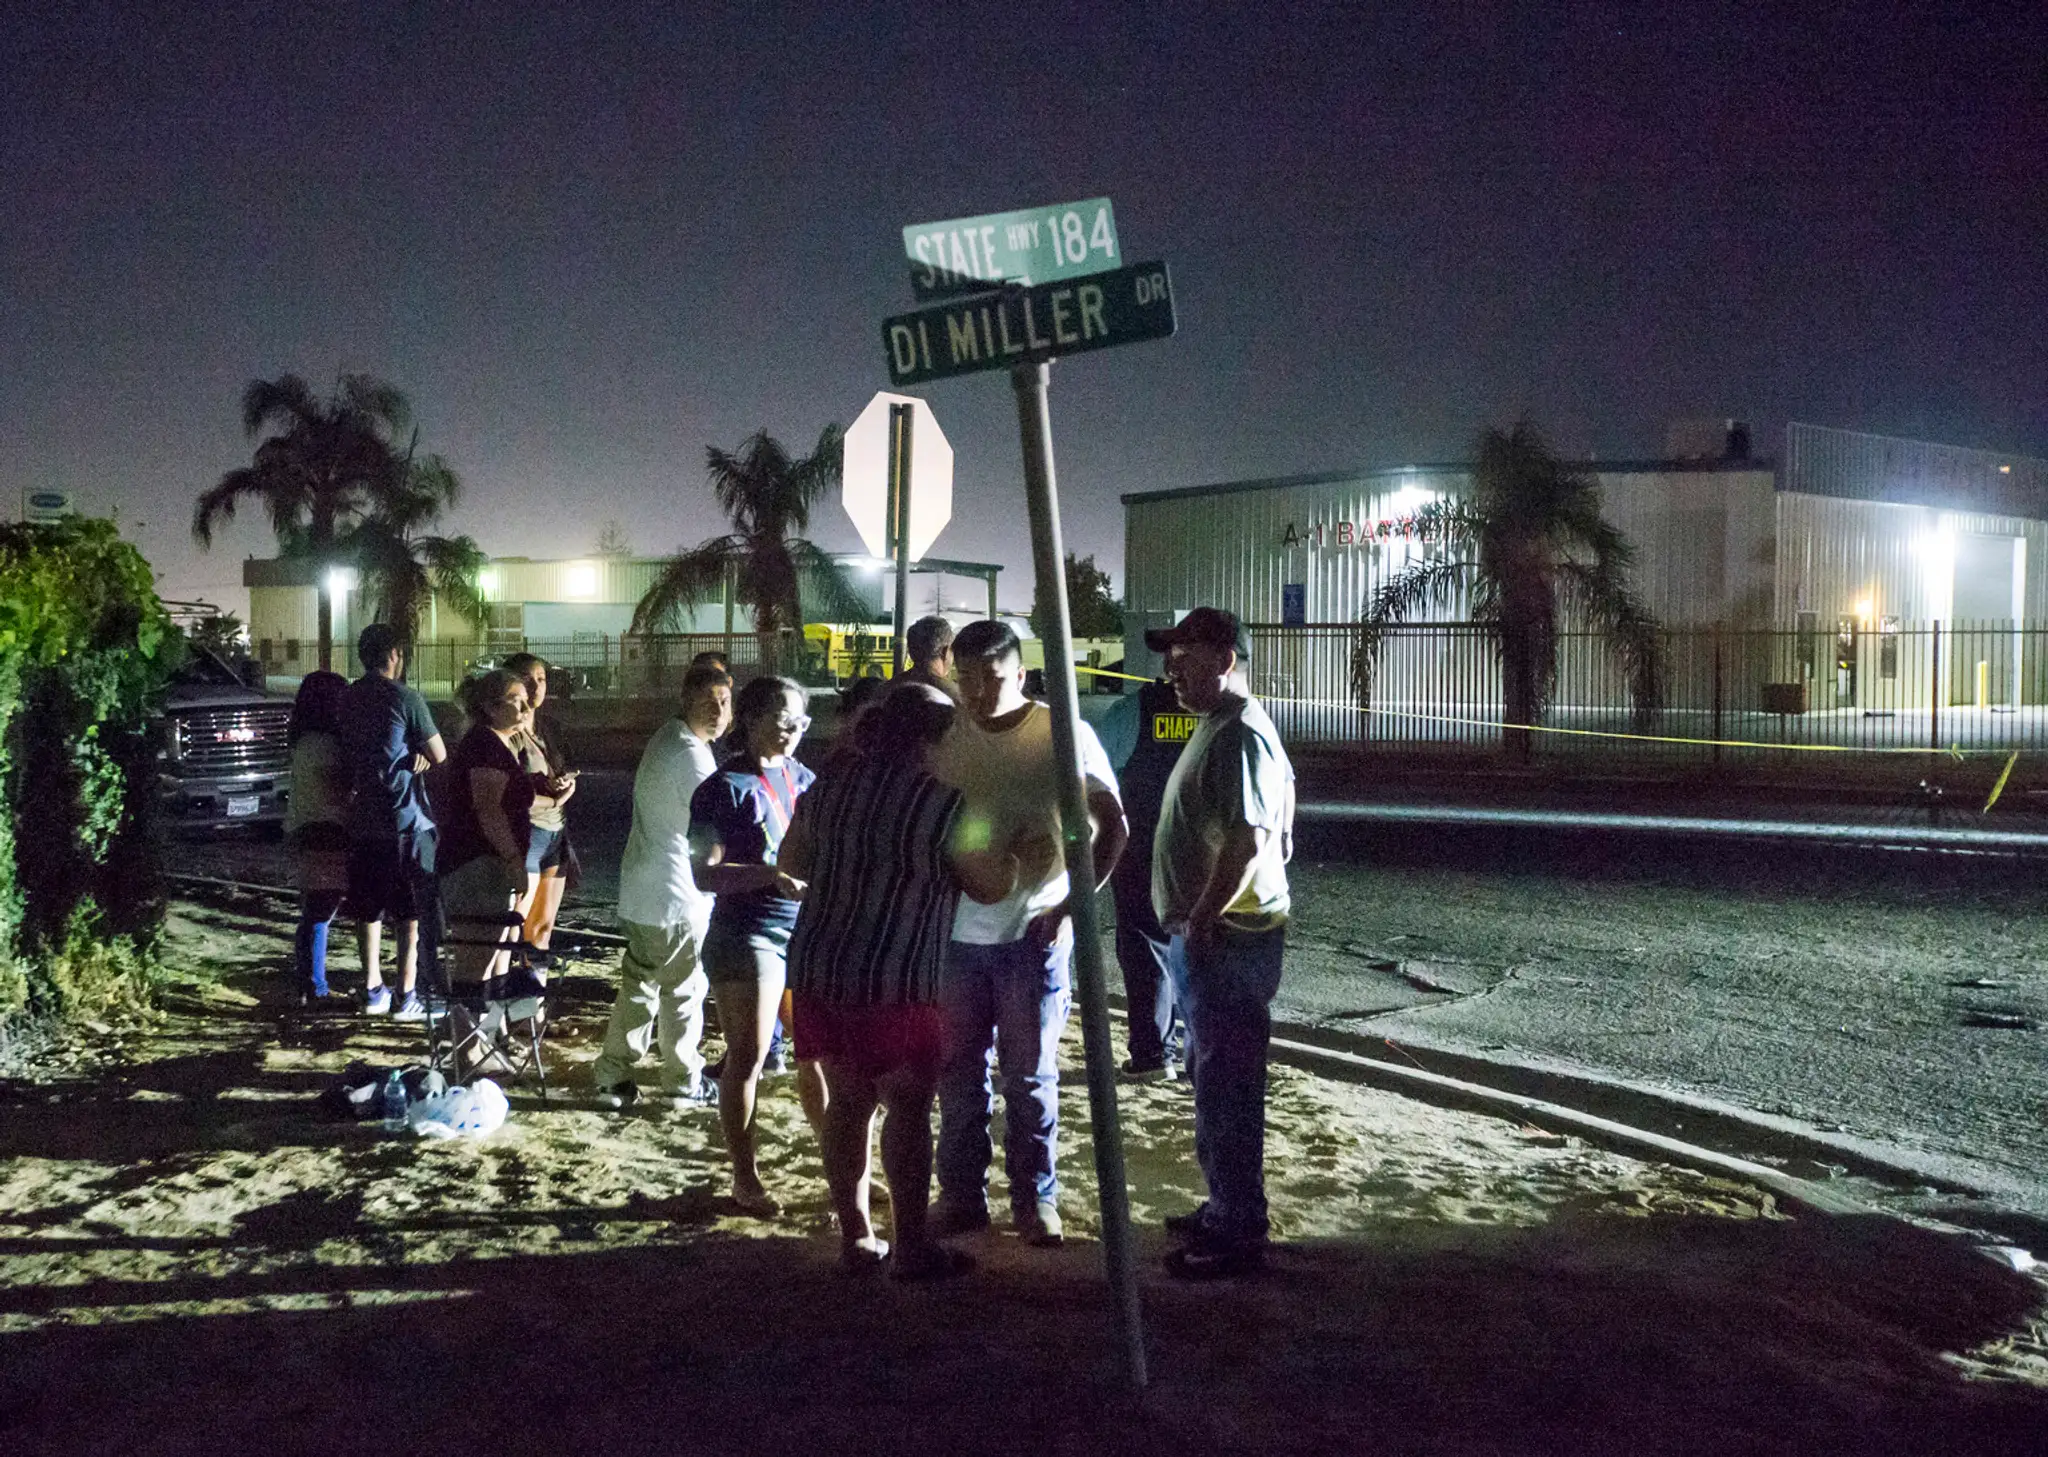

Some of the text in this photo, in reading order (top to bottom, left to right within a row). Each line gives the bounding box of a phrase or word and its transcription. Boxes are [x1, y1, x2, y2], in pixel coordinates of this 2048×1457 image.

[914, 208, 1115, 289] STATE HWY 184
[890, 272, 1169, 375] DI MILLER DR
